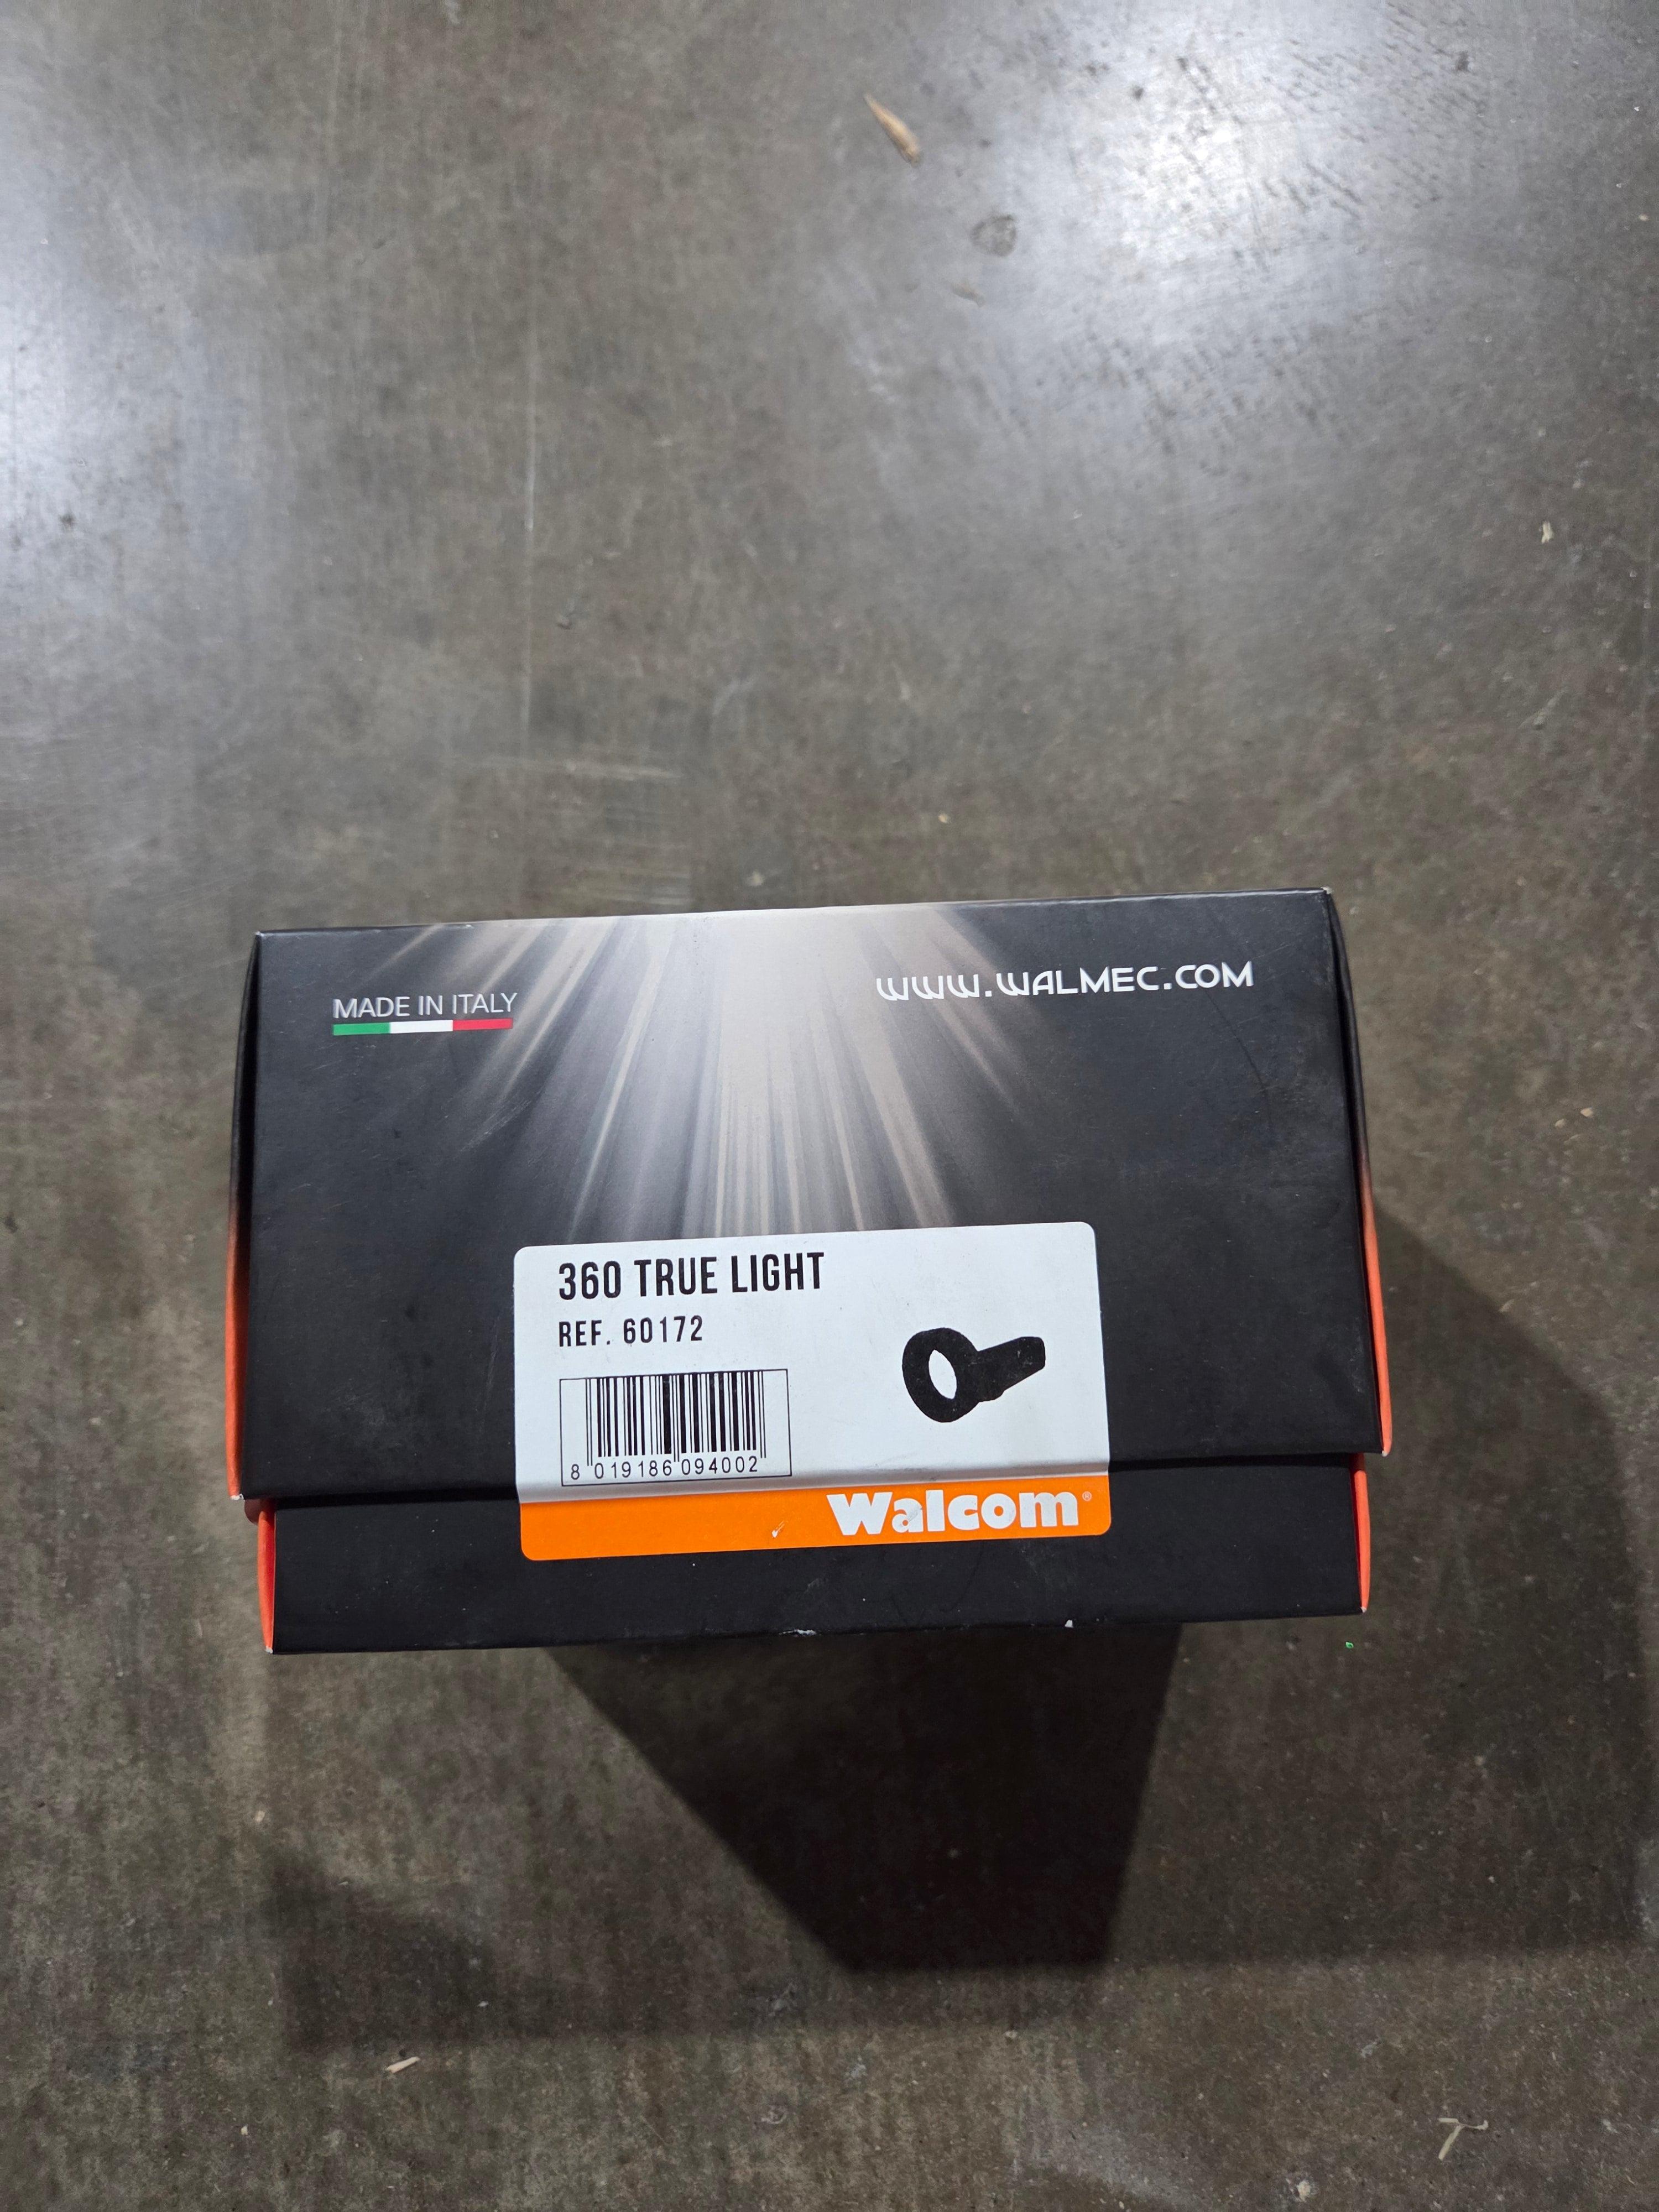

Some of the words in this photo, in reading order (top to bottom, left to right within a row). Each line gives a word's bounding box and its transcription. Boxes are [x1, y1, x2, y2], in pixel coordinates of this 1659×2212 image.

[876, 961, 1254, 1001] WWW.WALMEC.COM
[333, 995, 410, 1019] MADE
[418, 995, 444, 1016] IN
[451, 992, 518, 1014] ITALY
[559, 1260, 622, 1300] 360
[634, 1256, 718, 1297] TRUE
[731, 1251, 825, 1293] LIGHT
[559, 1319, 611, 1347] REF.
[623, 1315, 703, 1344] 60172
